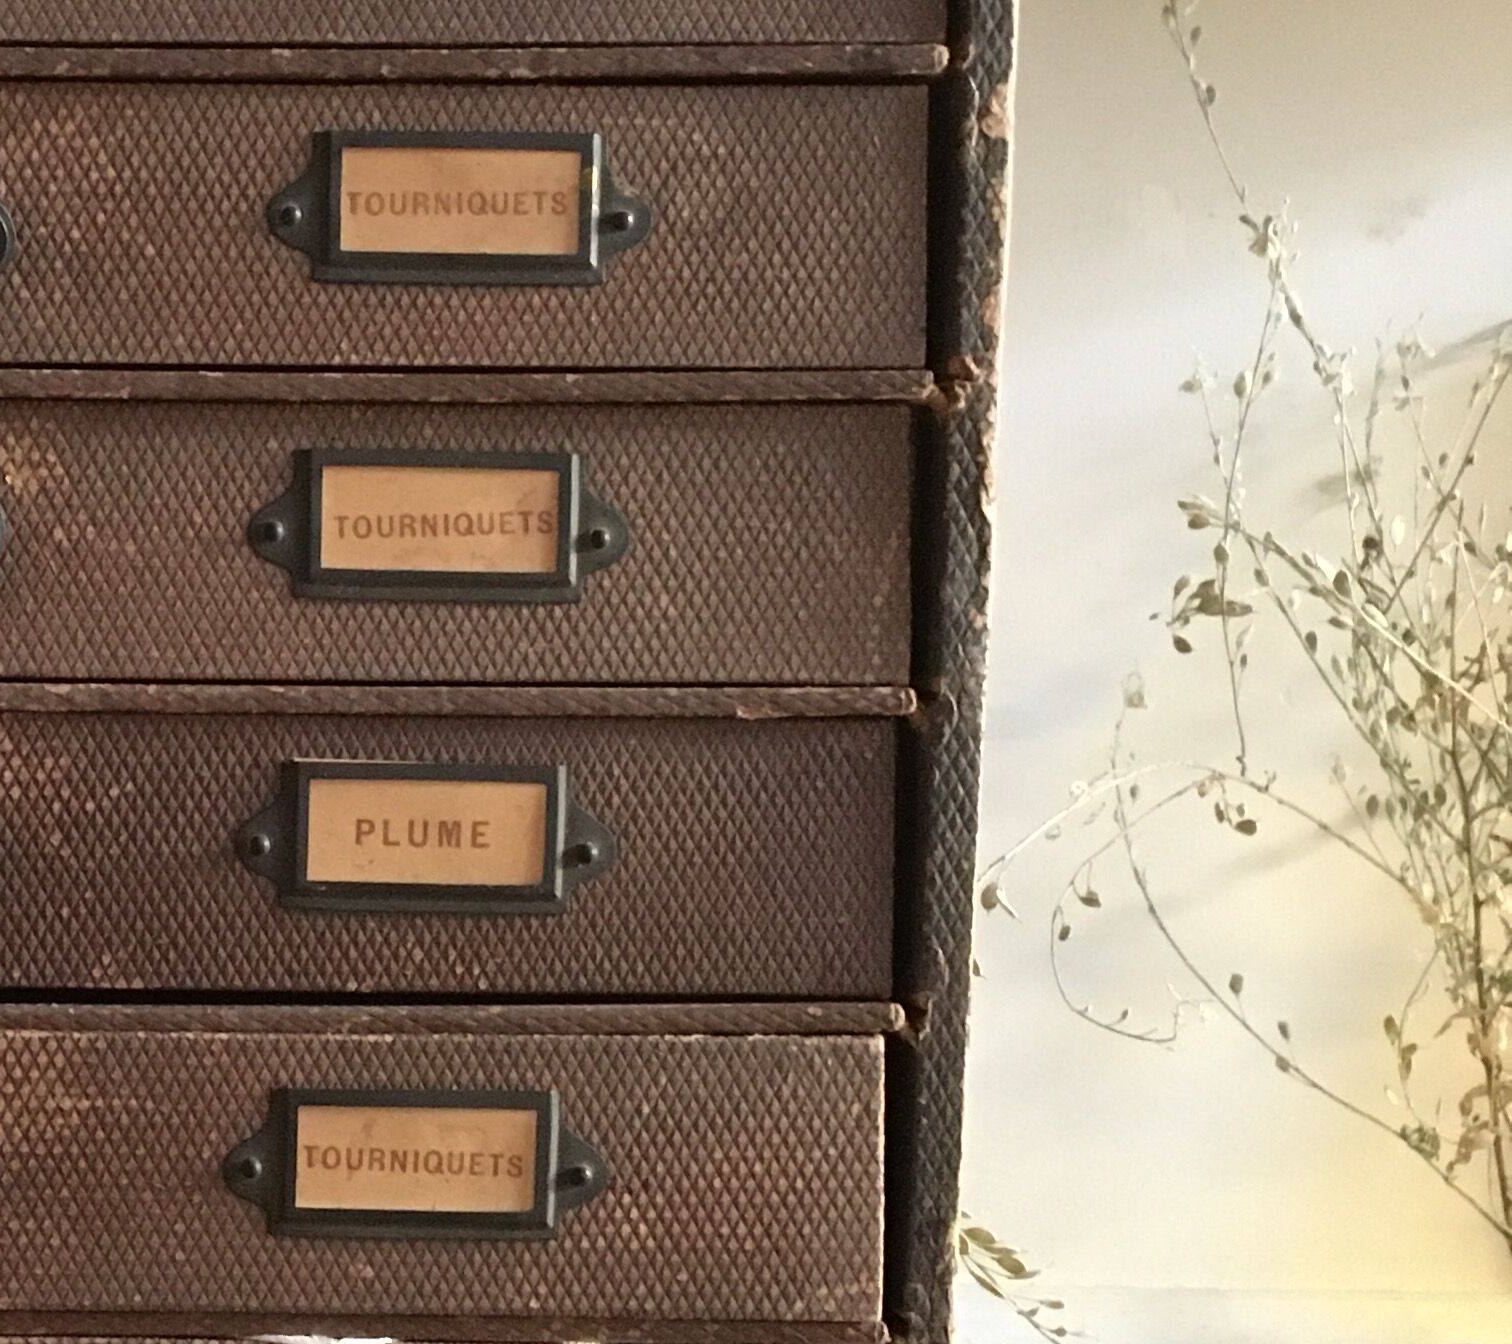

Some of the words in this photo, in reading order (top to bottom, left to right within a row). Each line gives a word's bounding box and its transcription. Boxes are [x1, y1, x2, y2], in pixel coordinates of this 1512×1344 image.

[347, 189, 568, 218] TOURNIQUETS
[334, 510, 554, 542] TOURNIQUETS
[354, 818, 493, 850] PLUME
[303, 1144, 525, 1178] TOURNIQUETS
